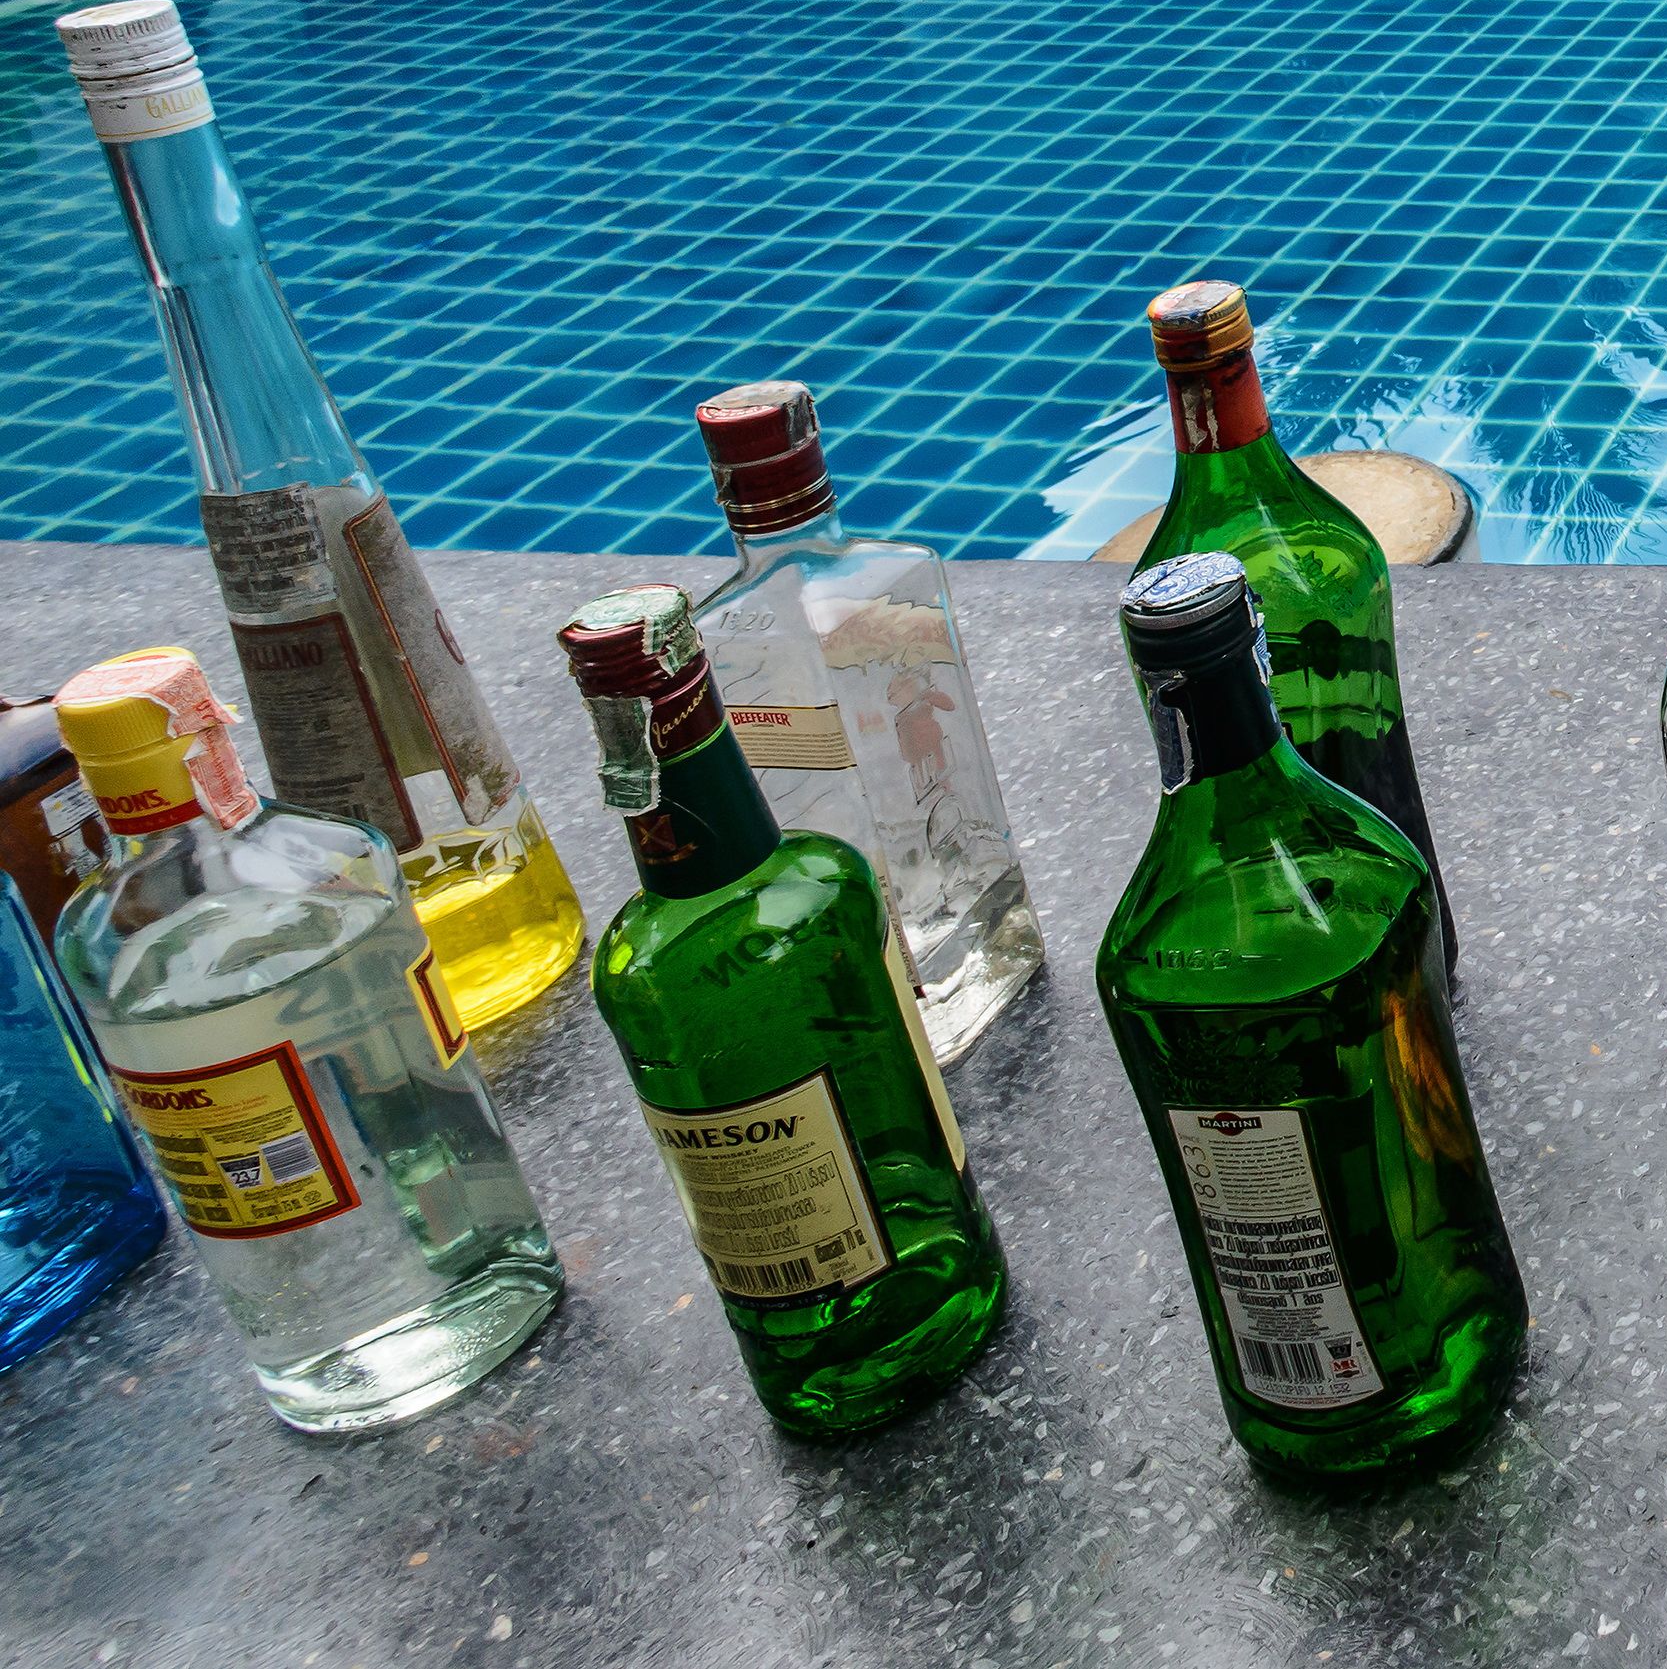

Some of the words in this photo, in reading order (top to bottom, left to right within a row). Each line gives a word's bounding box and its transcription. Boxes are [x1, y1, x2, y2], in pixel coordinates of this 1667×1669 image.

[731, 710, 791, 727] BEEFEATER
[655, 1115, 799, 1149] JAMESON
[1201, 1118, 1258, 1129] MARTINI
